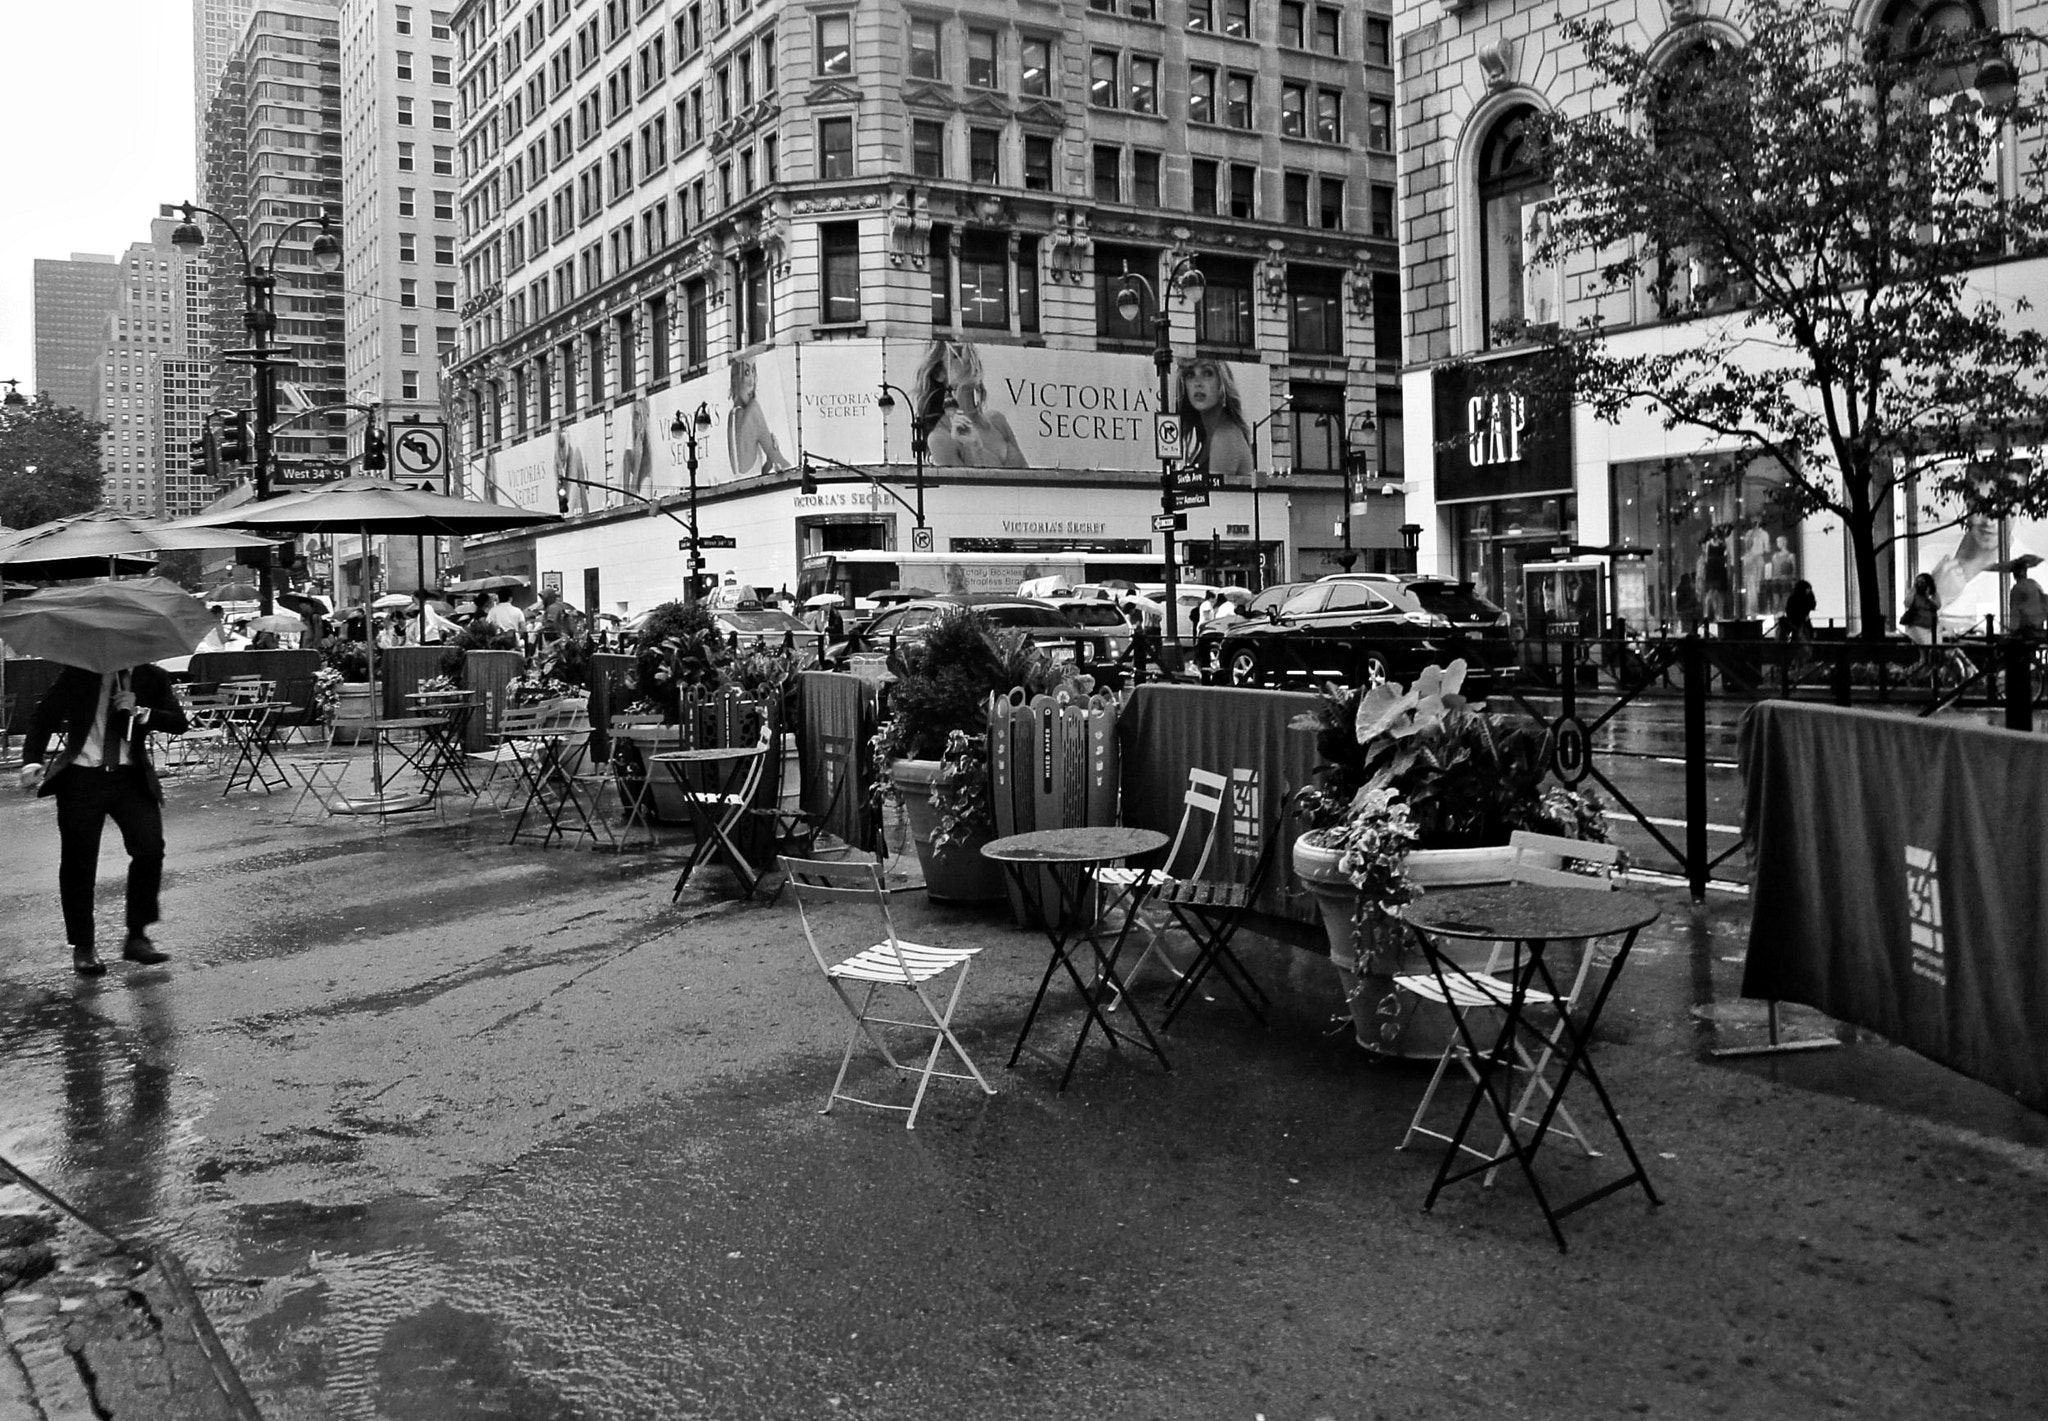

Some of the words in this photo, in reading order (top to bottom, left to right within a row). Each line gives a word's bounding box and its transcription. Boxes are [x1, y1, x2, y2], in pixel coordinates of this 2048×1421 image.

[805, 393, 880, 406] VICTORIA'S
[819, 406, 867, 418] SECRET
[1039, 410, 1142, 441] SECRET
[1468, 391, 1525, 467] GAP
[671, 435, 710, 466] SECET
[283, 468, 310, 479] West
[333, 469, 345, 480] St
[1002, 520, 1063, 533] VICTORIA'S
[1067, 521, 1105, 533] SECRET
